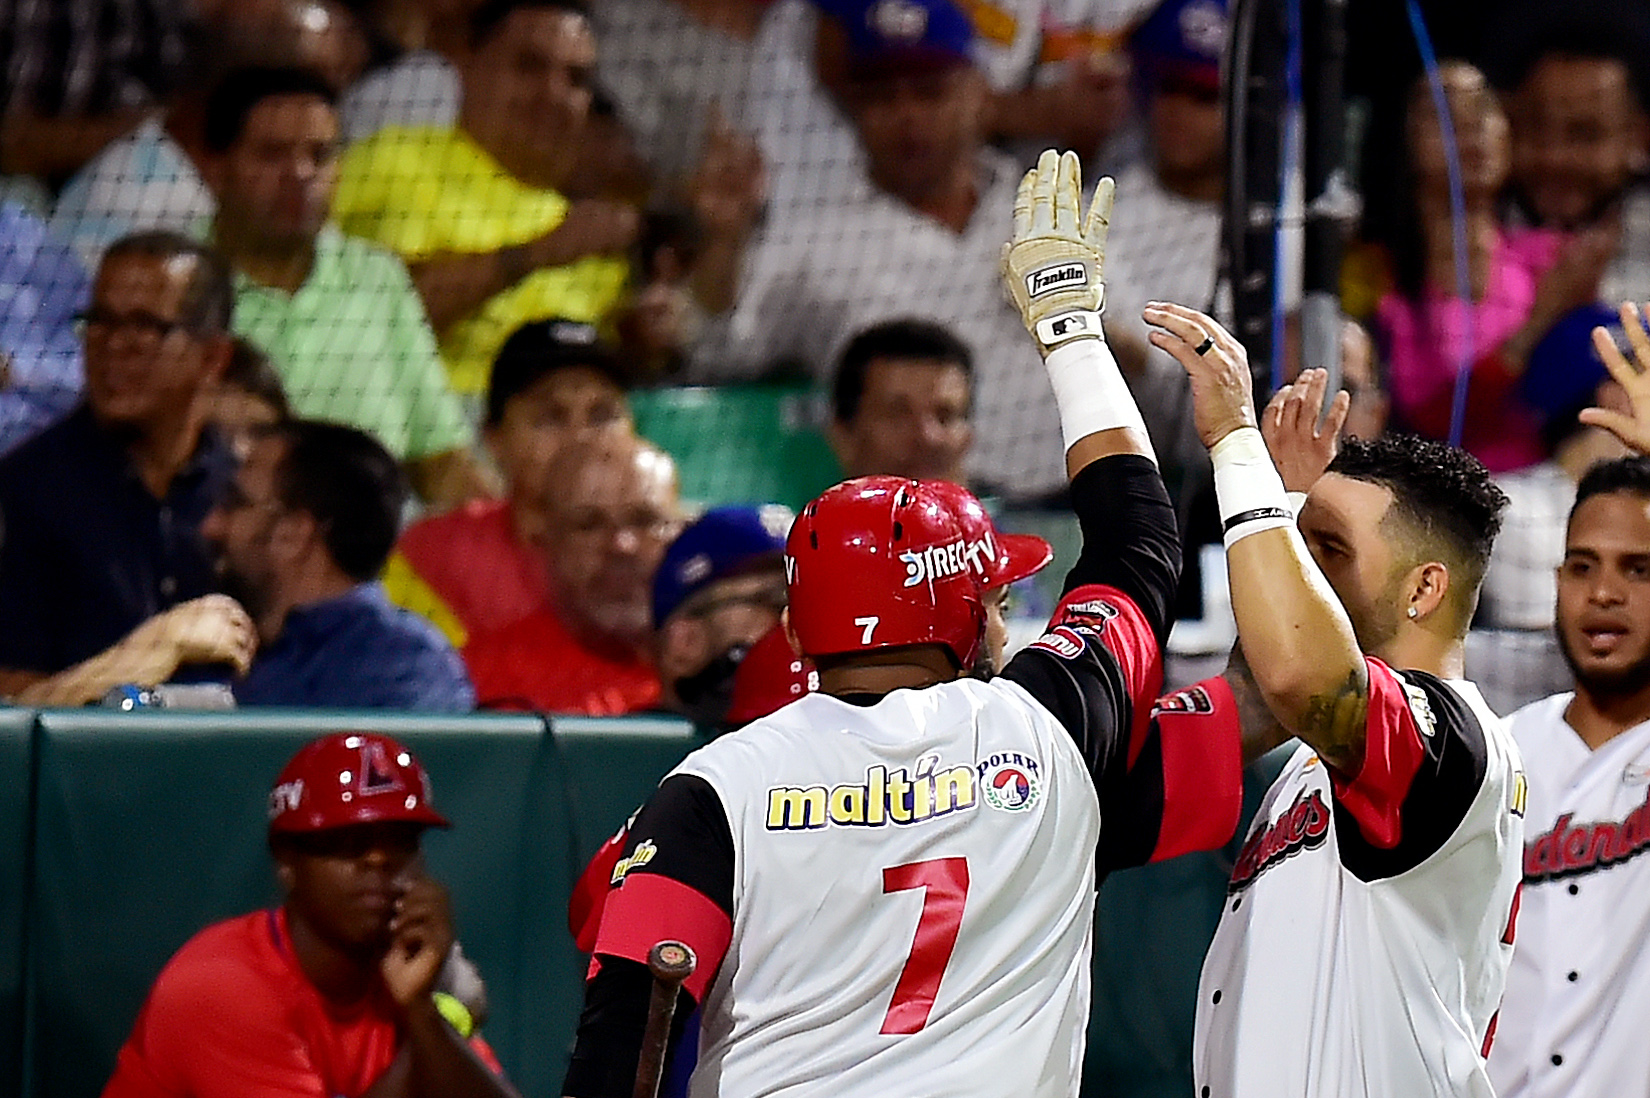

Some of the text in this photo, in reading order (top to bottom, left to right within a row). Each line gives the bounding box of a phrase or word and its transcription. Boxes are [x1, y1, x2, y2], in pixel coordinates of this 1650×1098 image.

[854, 616, 880, 645] 7
[976, 753, 1040, 783] POLAR
[878, 856, 971, 1036] 7
